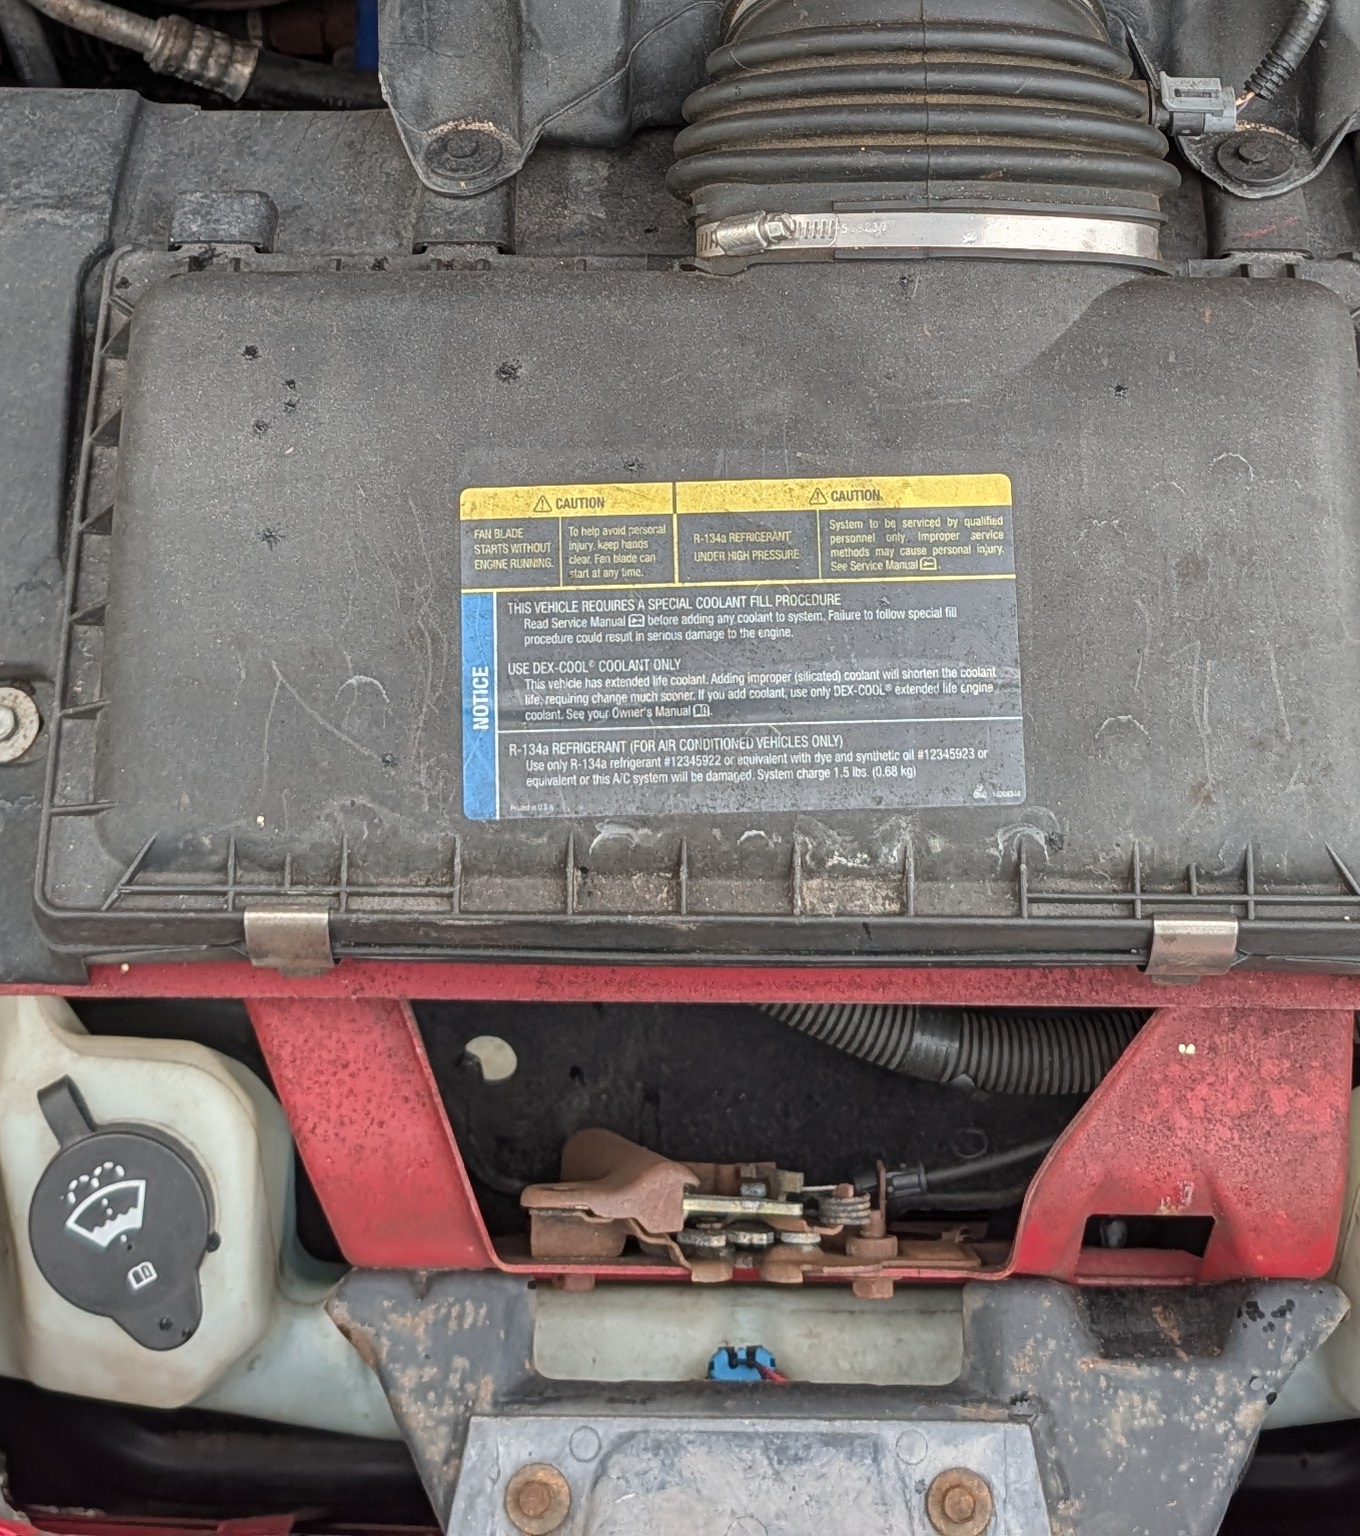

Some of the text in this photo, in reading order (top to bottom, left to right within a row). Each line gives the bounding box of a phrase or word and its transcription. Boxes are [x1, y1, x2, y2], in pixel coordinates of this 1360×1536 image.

[831, 489, 880, 502] CAUTION
[556, 497, 604, 510] CAUTION
[474, 528, 524, 539] FAN BLADE
[694, 531, 791, 544] R-134a REFRIGERANT
[474, 542, 551, 555] STARTS WITHOUT
[694, 549, 799, 562] UNDER HIGH PRESSURE
[475, 559, 507, 570] ENGINE
[507, 594, 842, 614] THIS VEHICLE REQUIRES A SPECIAL COOLANT FILL PROCEDURE
[524, 606, 957, 630] Read Service Manual before adding any coolant to system. Failure to follow special fill
[524, 633, 573, 647] procedure
[576, 632, 603, 643] could
[636, 630, 644, 642] in
[647, 629, 682, 641] serious
[685, 629, 724, 642] damage
[727, 629, 737, 639] to
[740, 627, 755, 638] the
[758, 627, 794, 640] engine.
[508, 662, 529, 675] USE
[598, 659, 650, 673] COOLANT
[653, 658, 681, 671] ONLY
[472, 666, 489, 730] NOTICE
[509, 734, 844, 757] R-134a REFRIGERANT (FOR AIR CONDITIONED VEHICLES ONLY)
[526, 748, 988, 772] Use only R-134a refrigerant #12345922 or equivalent with dye and synthetic oil #12345923 or
